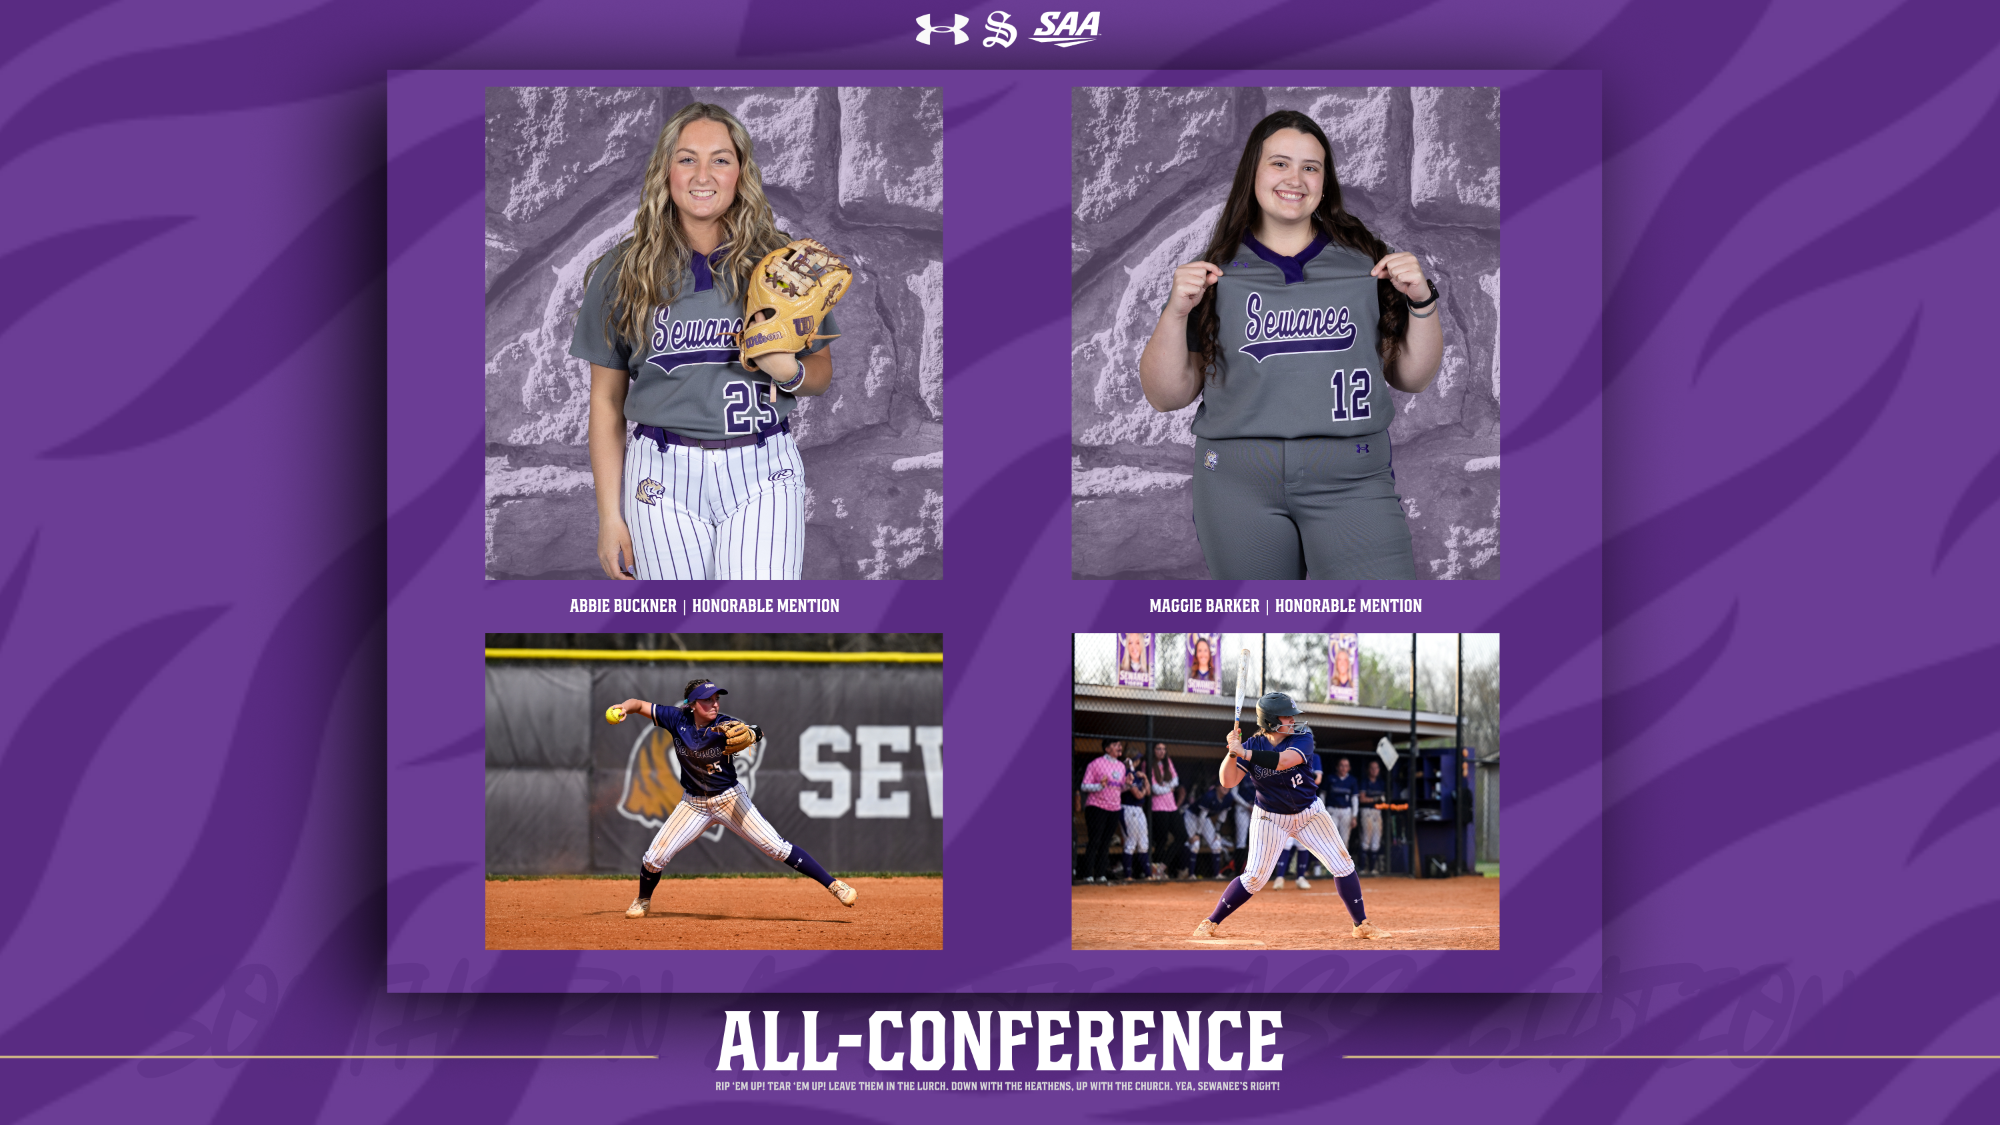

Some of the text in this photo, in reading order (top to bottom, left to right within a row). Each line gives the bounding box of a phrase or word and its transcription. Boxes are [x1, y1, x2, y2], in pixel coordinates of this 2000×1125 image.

[1245, 291, 1354, 341] Sewanee
[745, 330, 782, 349] Wilson
[722, 380, 779, 435] 25
[1331, 368, 1372, 422] 12
[705, 760, 723, 775] 25
[1290, 773, 1304, 789] 12
